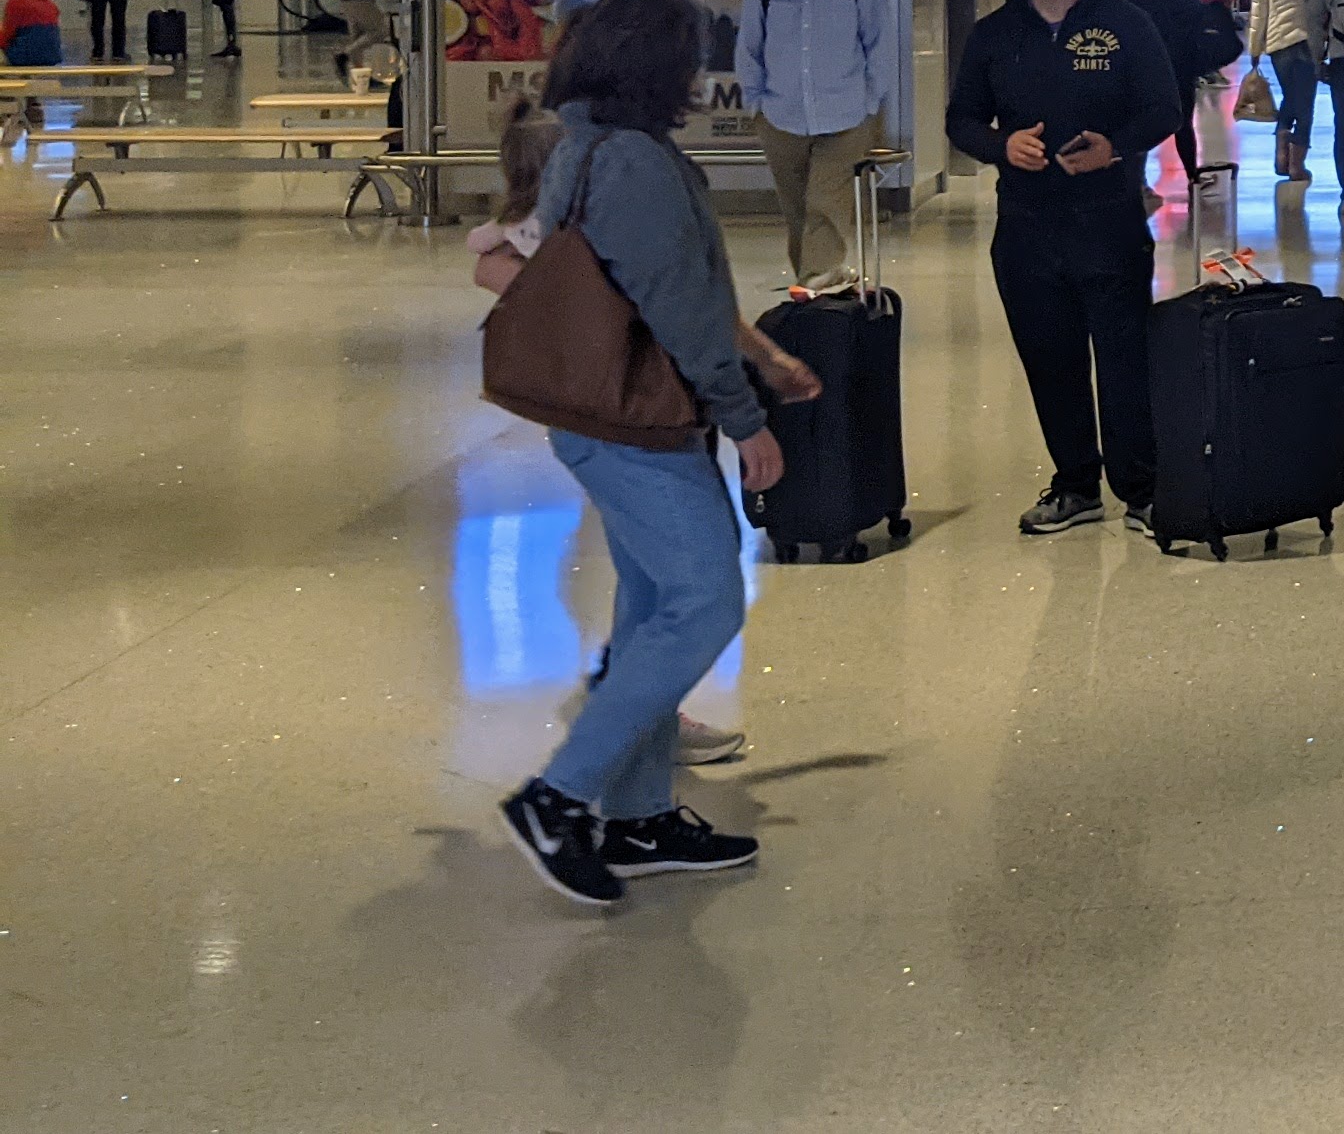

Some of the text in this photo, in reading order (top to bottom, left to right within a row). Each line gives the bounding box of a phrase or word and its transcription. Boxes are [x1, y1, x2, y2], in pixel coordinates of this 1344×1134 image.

[1064, 28, 1120, 51] NEW ORLEANS
[1073, 59, 1111, 71] SAINTS
